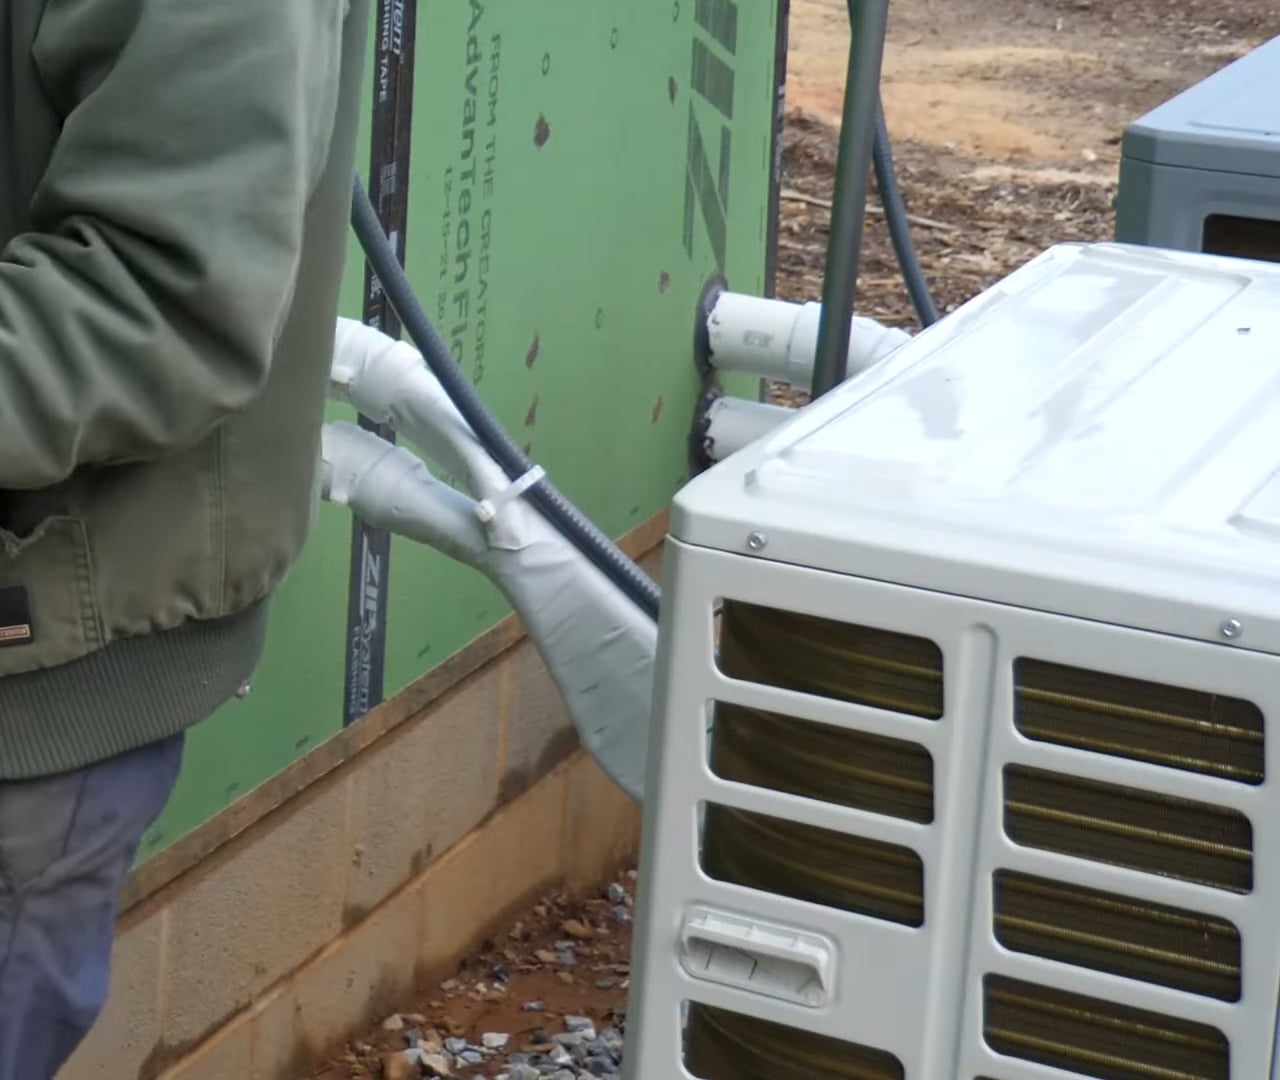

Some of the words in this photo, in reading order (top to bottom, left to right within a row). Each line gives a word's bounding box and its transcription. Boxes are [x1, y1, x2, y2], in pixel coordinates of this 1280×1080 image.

[378, 55, 389, 103] TAPE
[486, 33, 501, 127] FROM
[483, 133, 496, 199] THE
